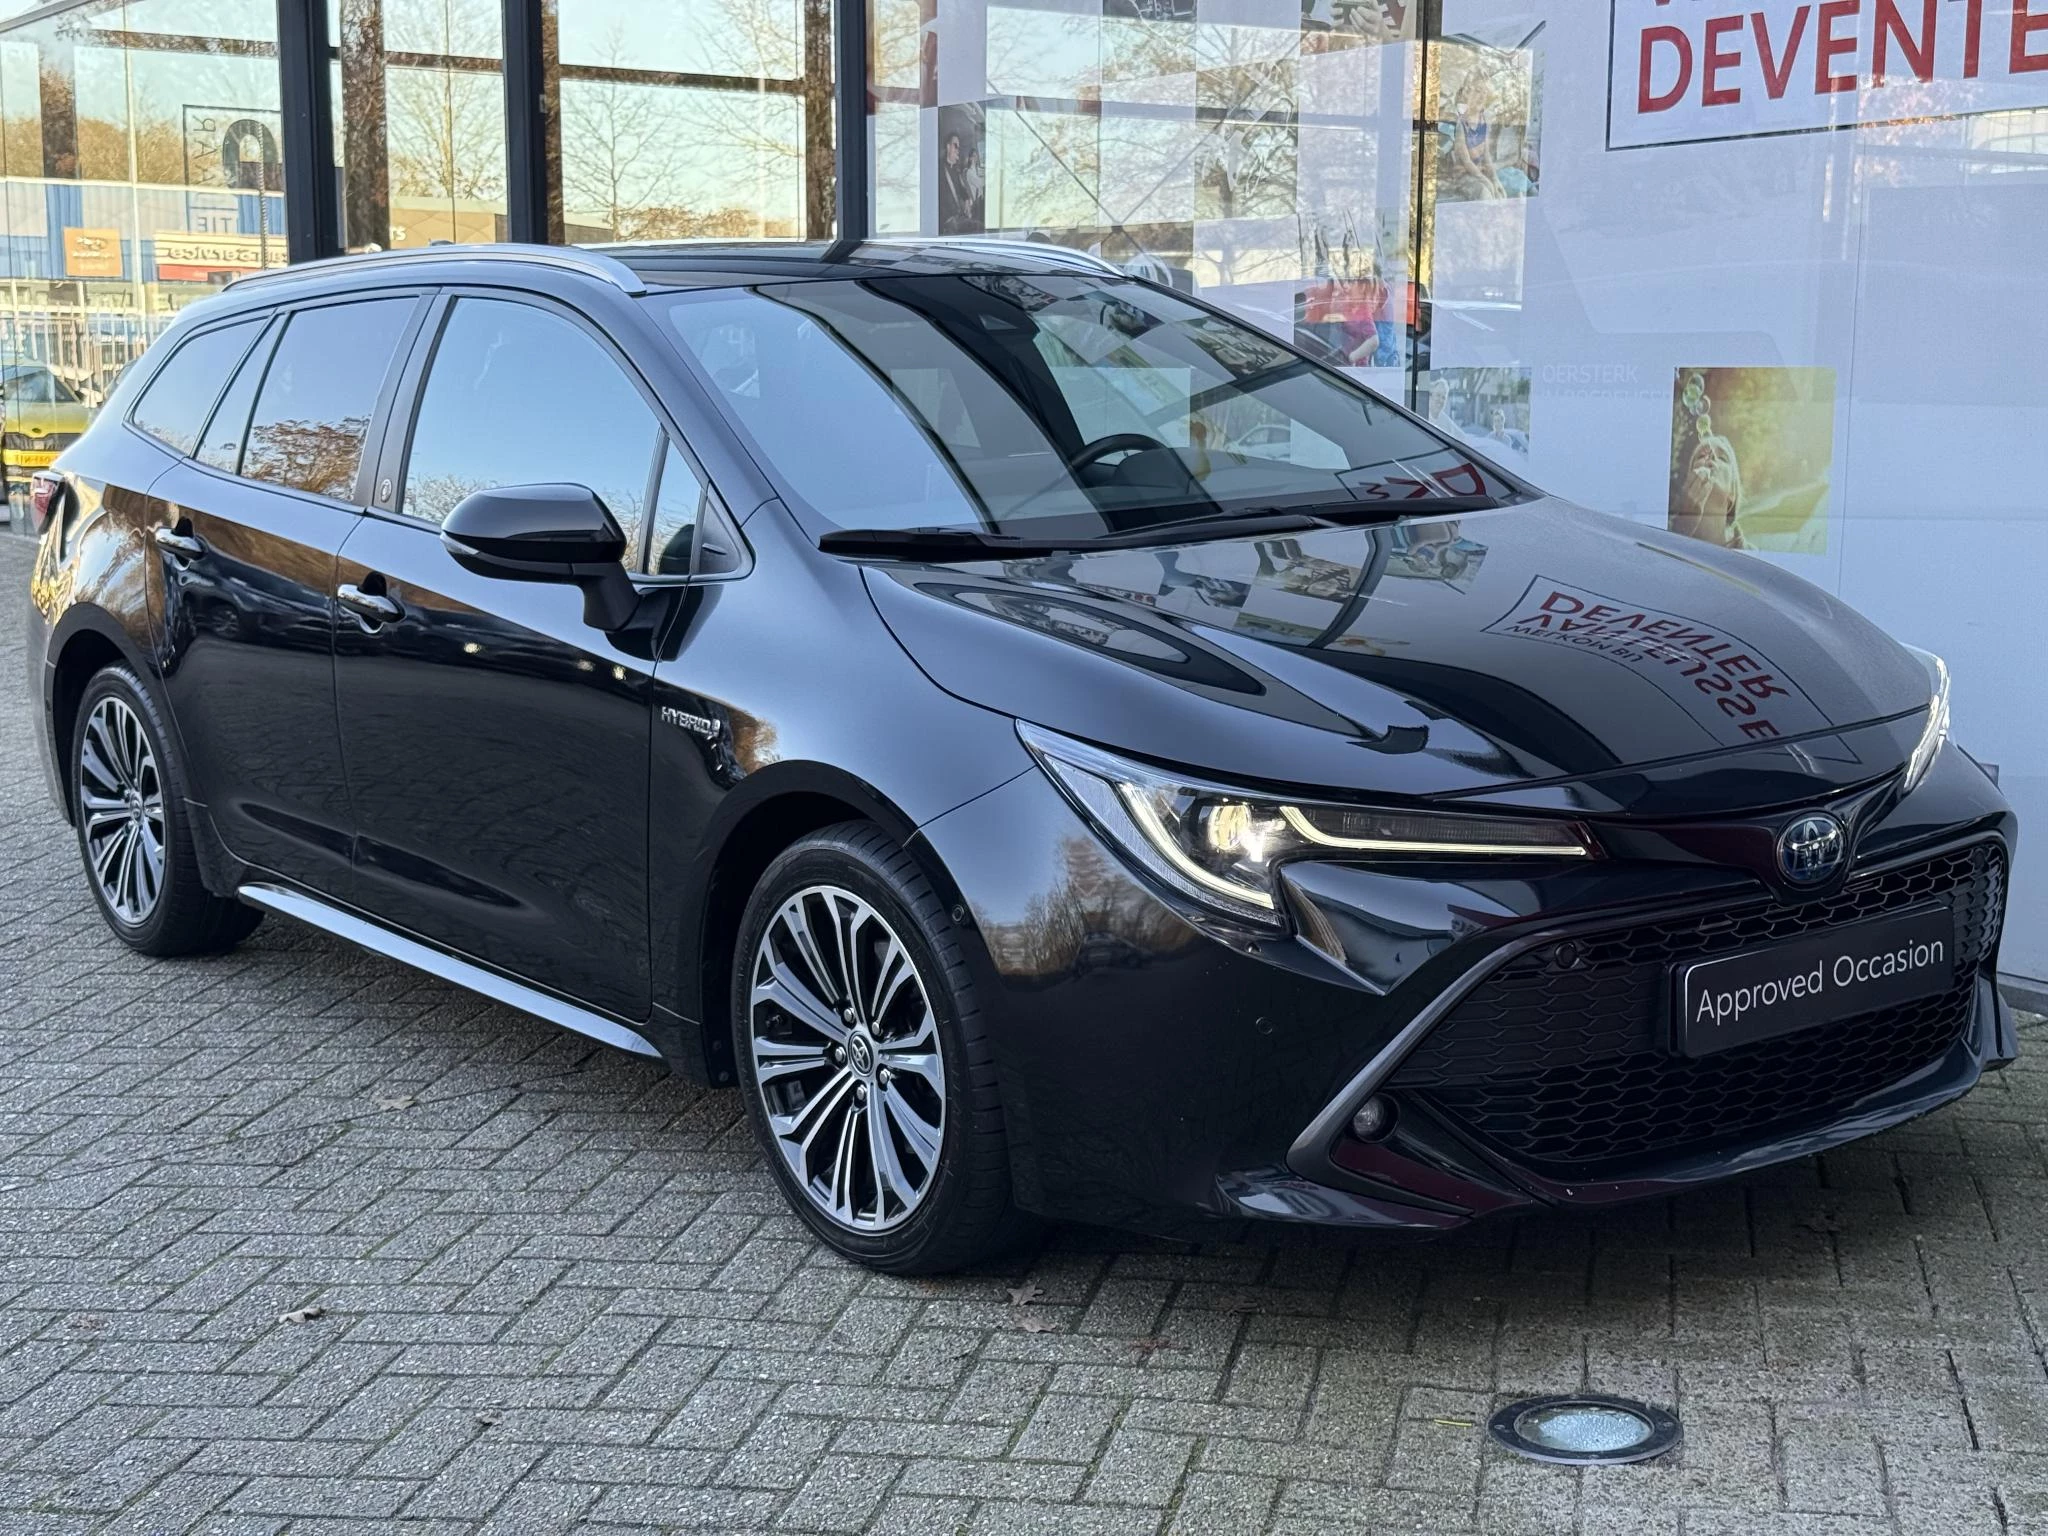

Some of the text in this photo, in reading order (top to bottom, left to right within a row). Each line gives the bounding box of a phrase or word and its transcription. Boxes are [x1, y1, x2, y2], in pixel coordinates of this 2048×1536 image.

[662, 706, 712, 735] HYBRID
[1696, 940, 1944, 1026] Approved Occasion
